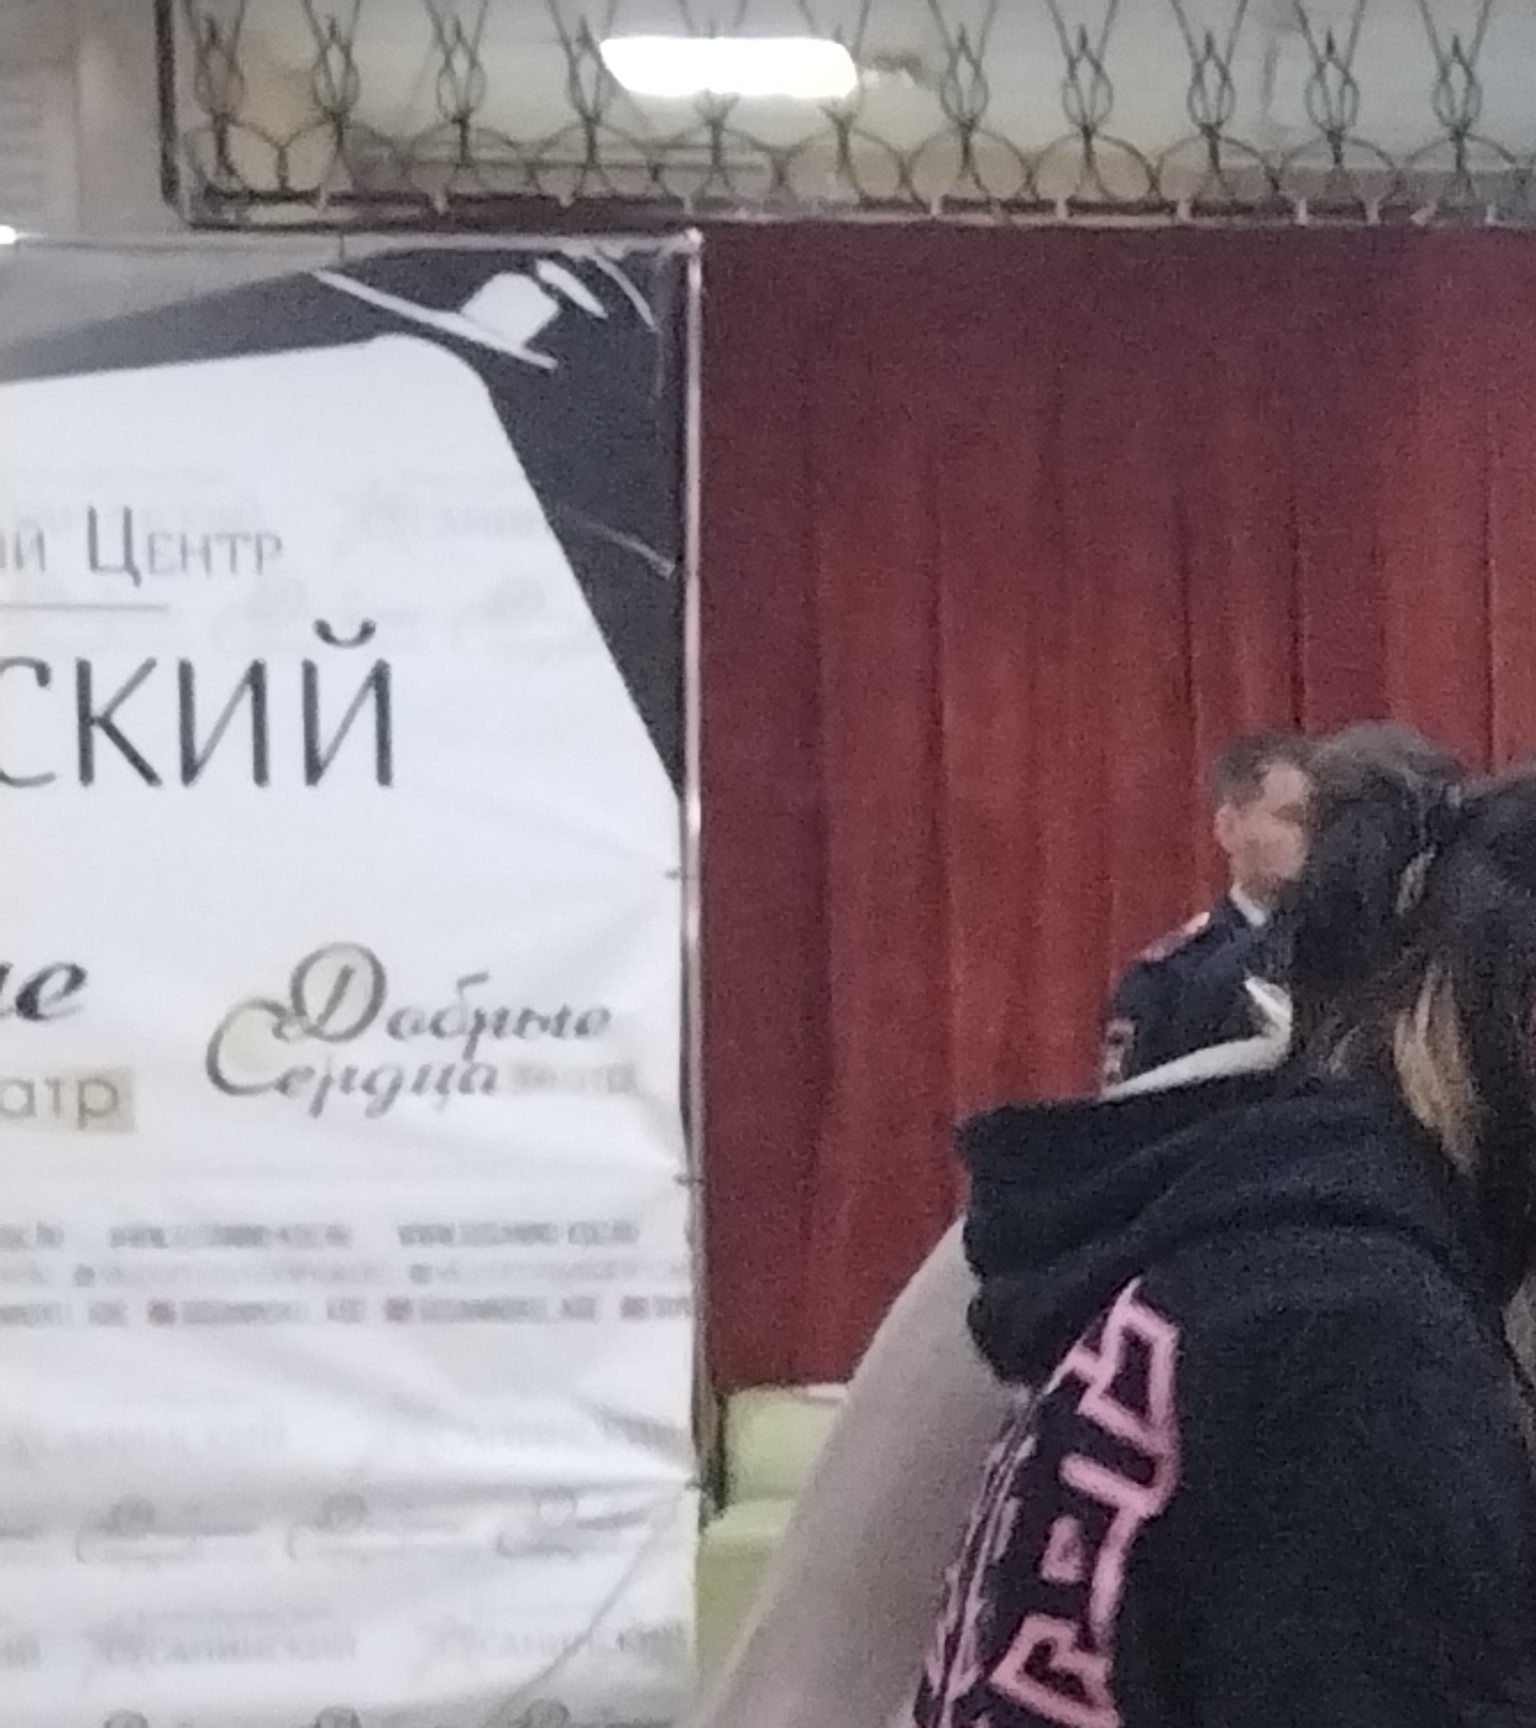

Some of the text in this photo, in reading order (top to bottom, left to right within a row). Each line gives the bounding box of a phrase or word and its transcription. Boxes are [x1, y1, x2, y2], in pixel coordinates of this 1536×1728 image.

[0, 514, 47, 574] Й
[205, 997, 499, 1119] Сердца
[289, 942, 612, 1061] Добрые
